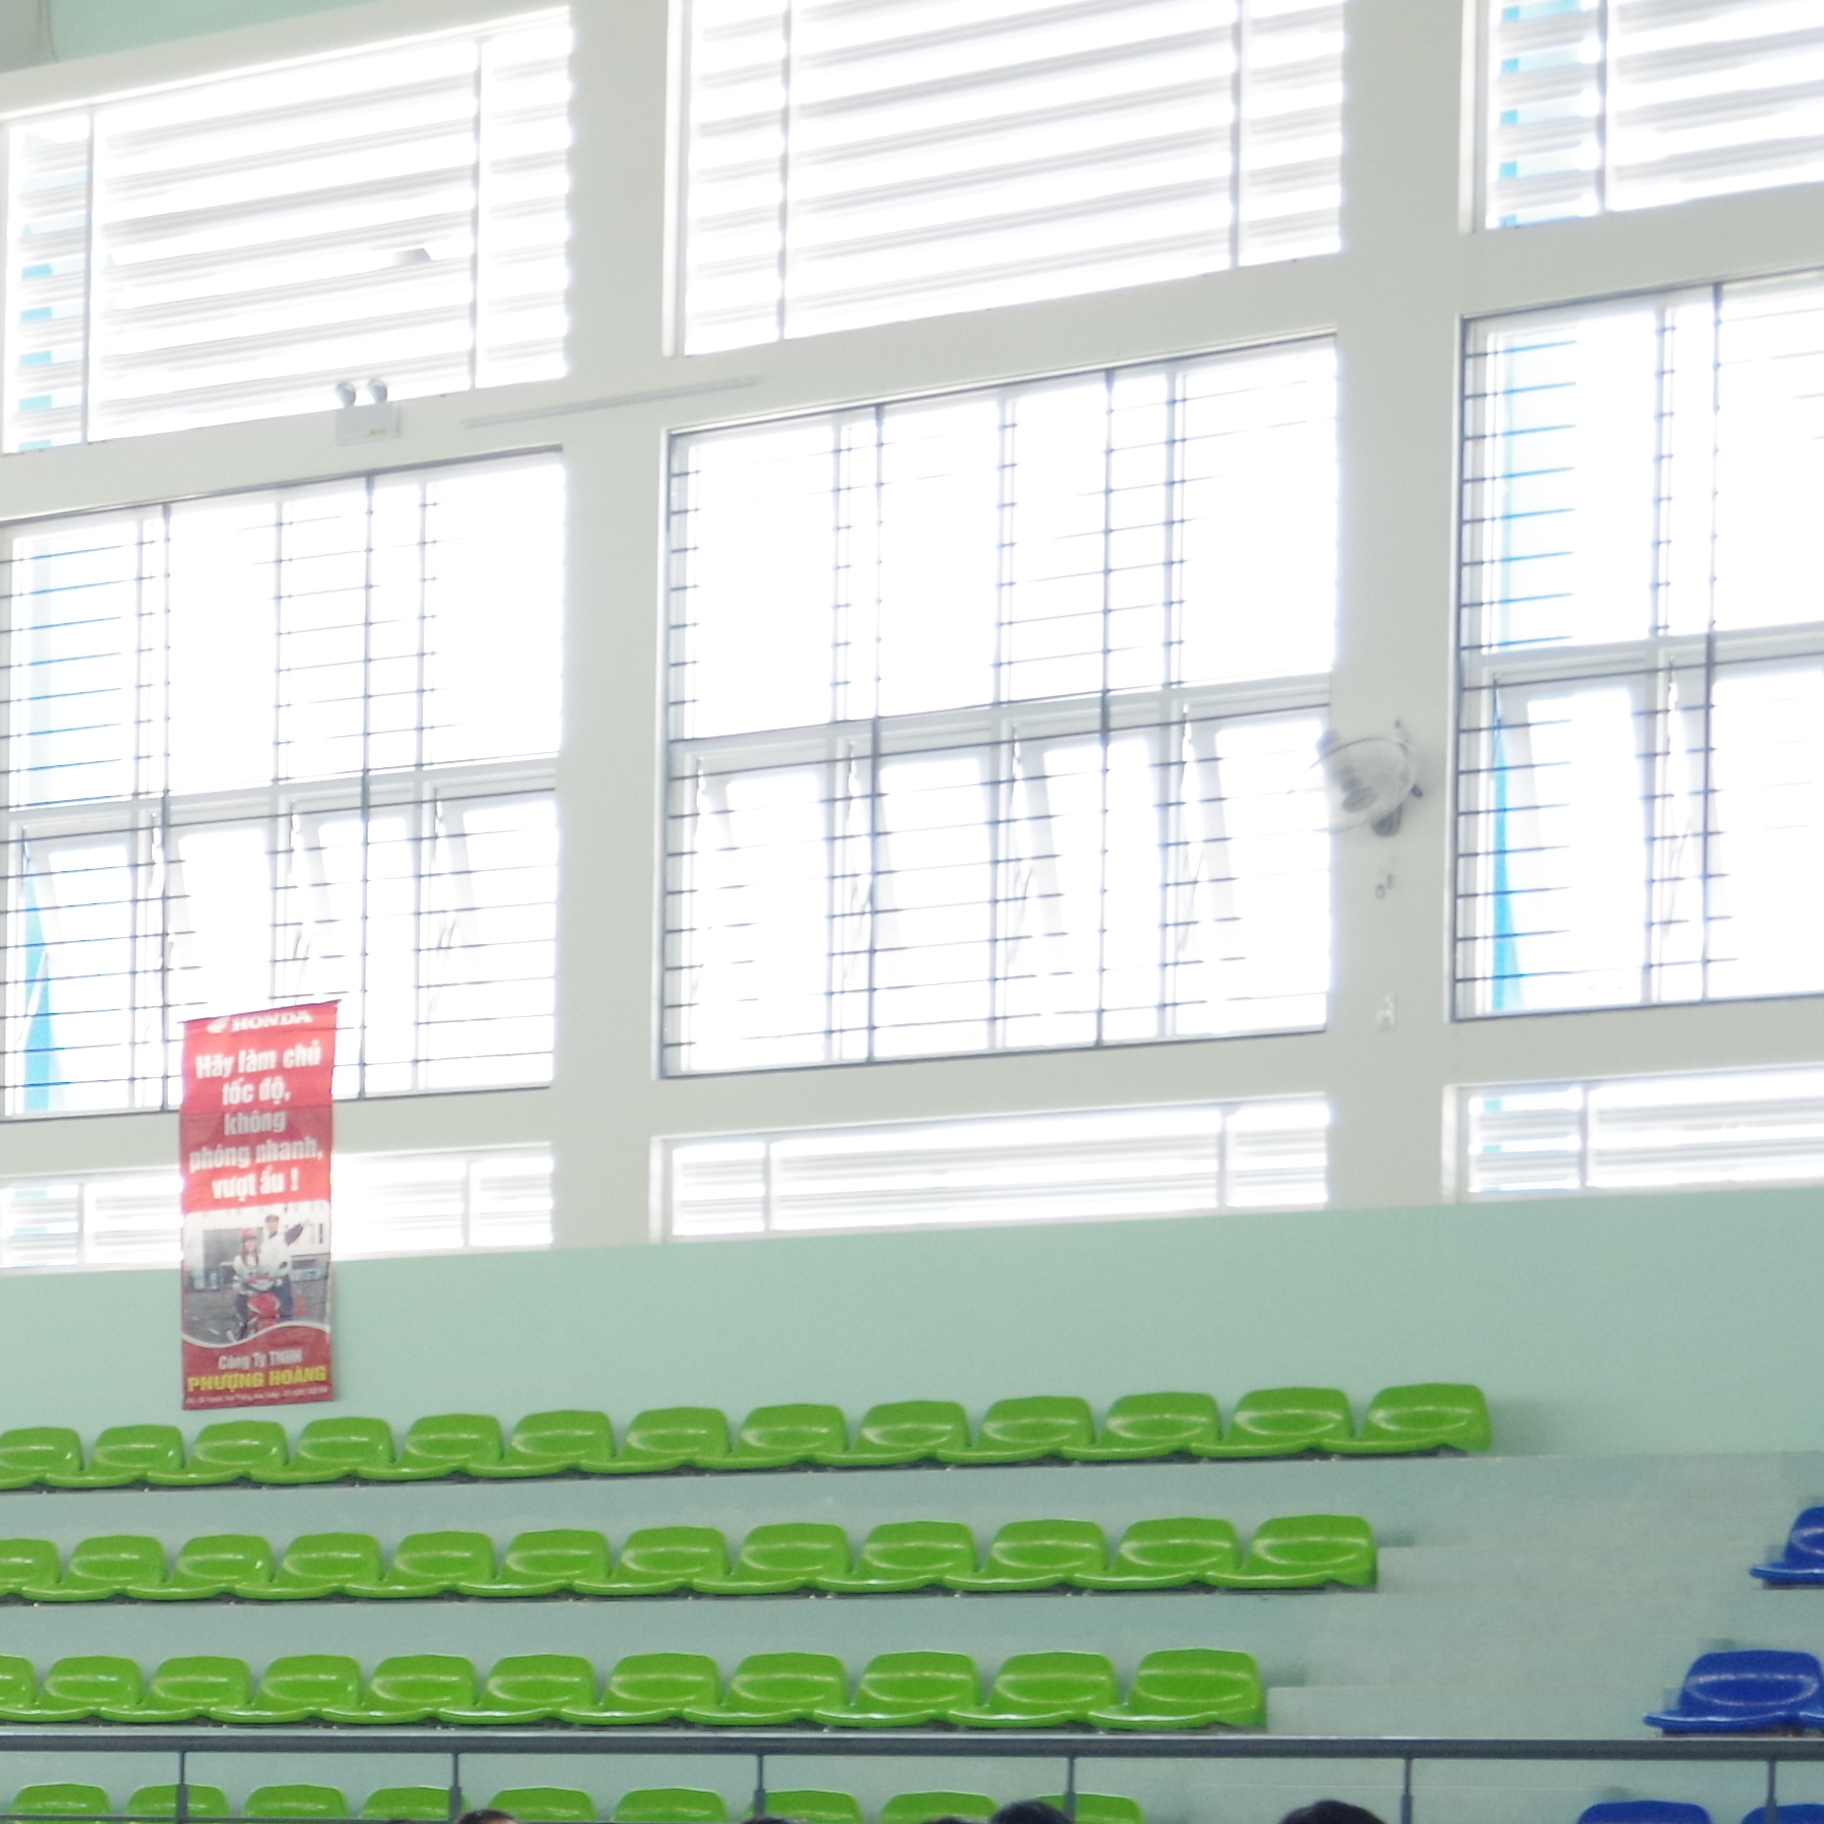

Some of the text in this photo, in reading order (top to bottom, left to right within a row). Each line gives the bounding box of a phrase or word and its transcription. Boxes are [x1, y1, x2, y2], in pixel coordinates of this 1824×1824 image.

[231, 1011, 314, 1032] HONDA
[195, 1039, 322, 1079] Hãy làm chủ
[222, 1075, 292, 1106] tốc độ,
[224, 1110, 287, 1136] không
[189, 1136, 323, 1174] phóng nhanh,
[212, 1174, 256, 1201] vượt
[260, 1165, 285, 1195] ẩu
[218, 1354, 250, 1370] Công
[187, 1365, 327, 1392] PHƯỢNG HOÀNG
